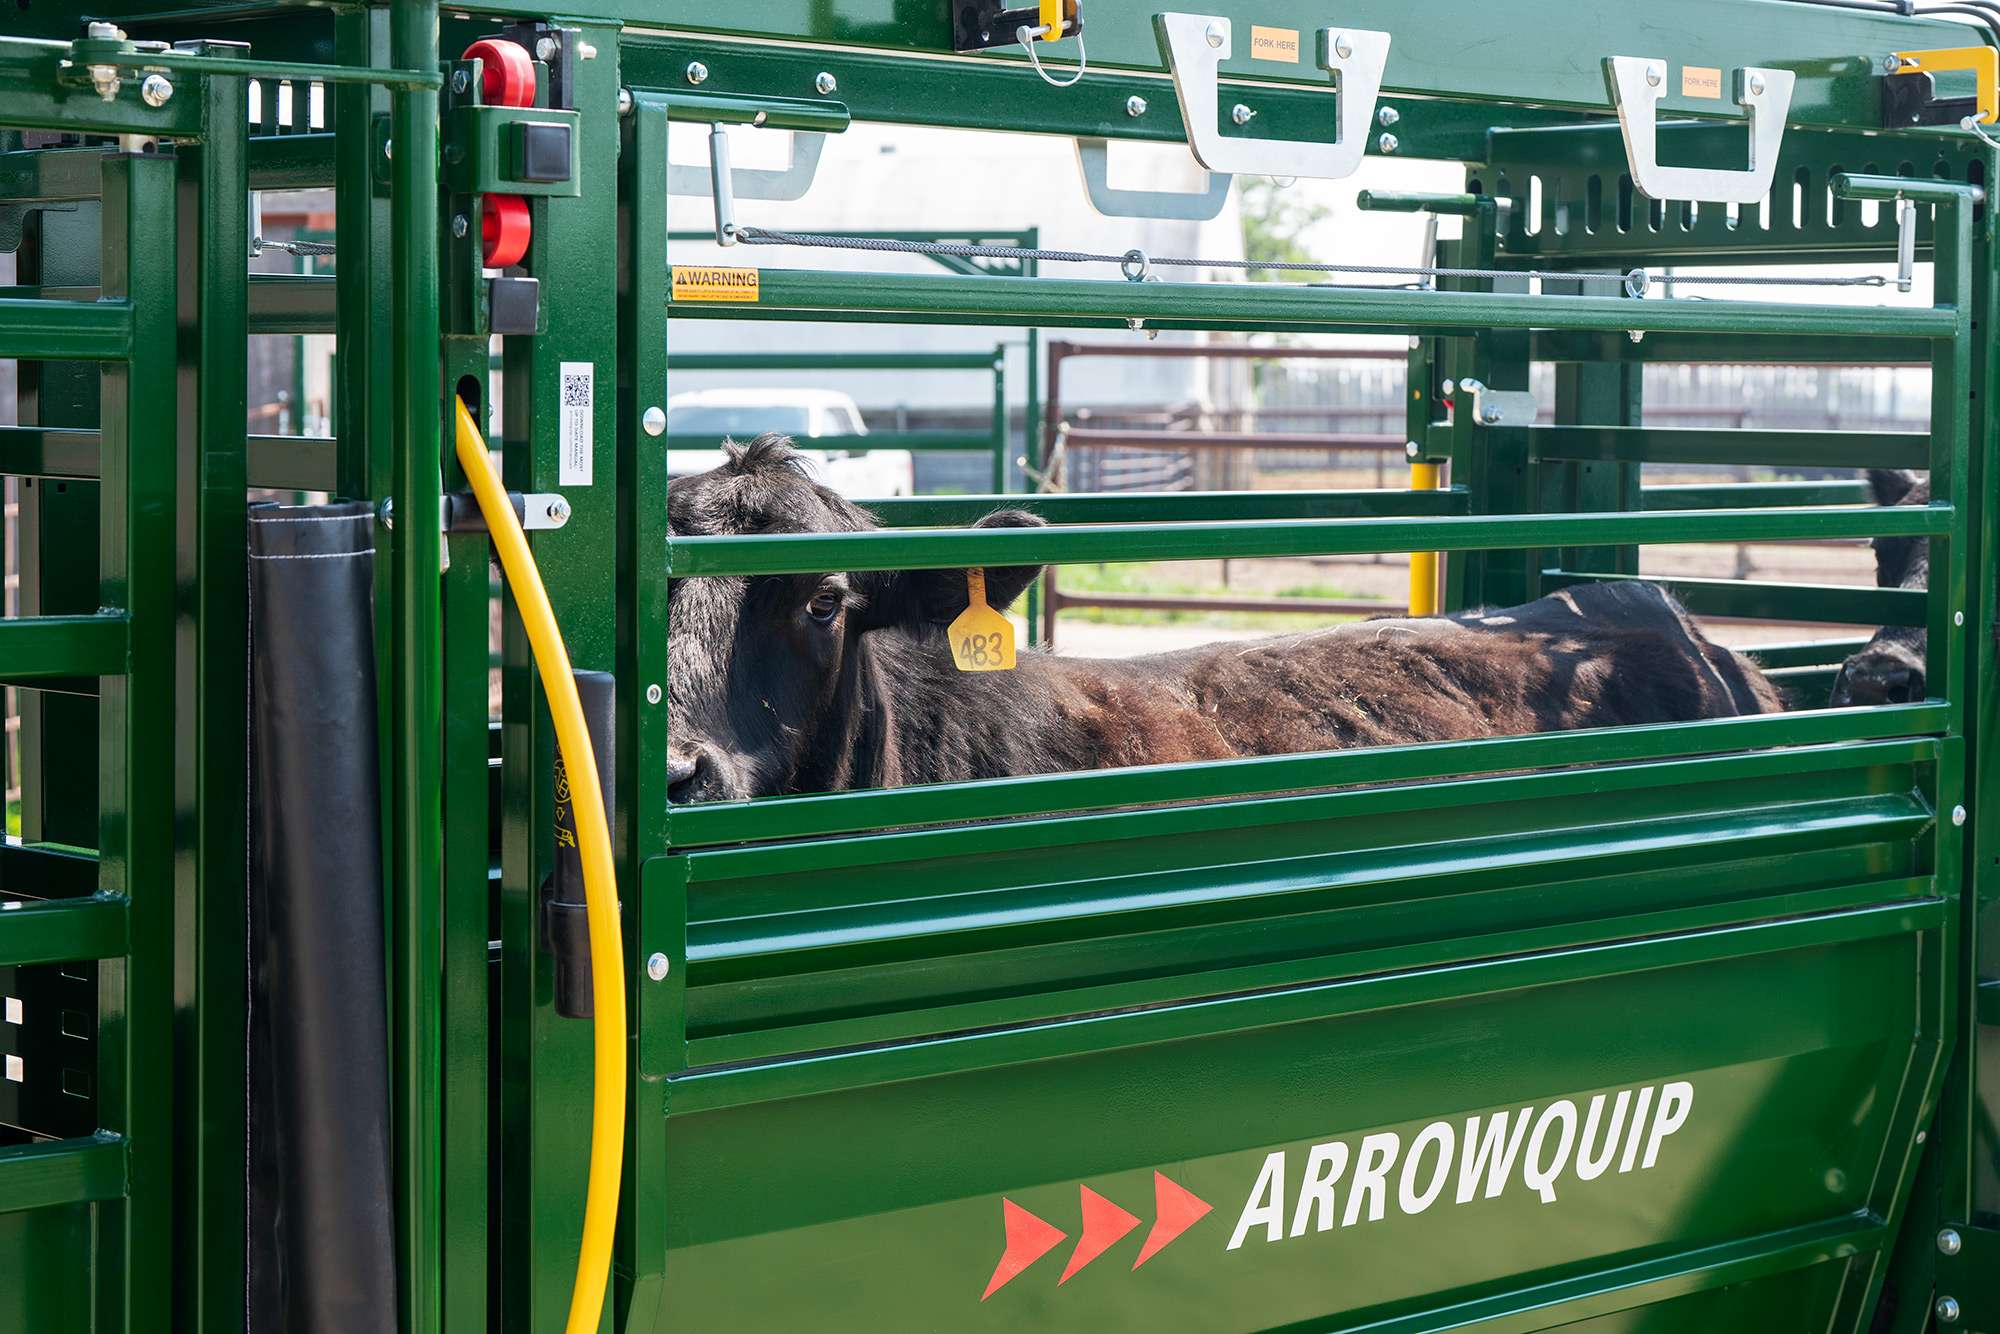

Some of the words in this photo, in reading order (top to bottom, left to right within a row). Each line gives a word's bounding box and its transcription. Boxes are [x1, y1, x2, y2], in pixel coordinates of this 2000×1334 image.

[1254, 37, 1274, 48] FORK
[1276, 40, 1296, 51] HERE
[688, 271, 757, 287] WARNING
[960, 632, 1004, 669] 483
[1226, 1081, 1694, 1251] ARROWQUIP
